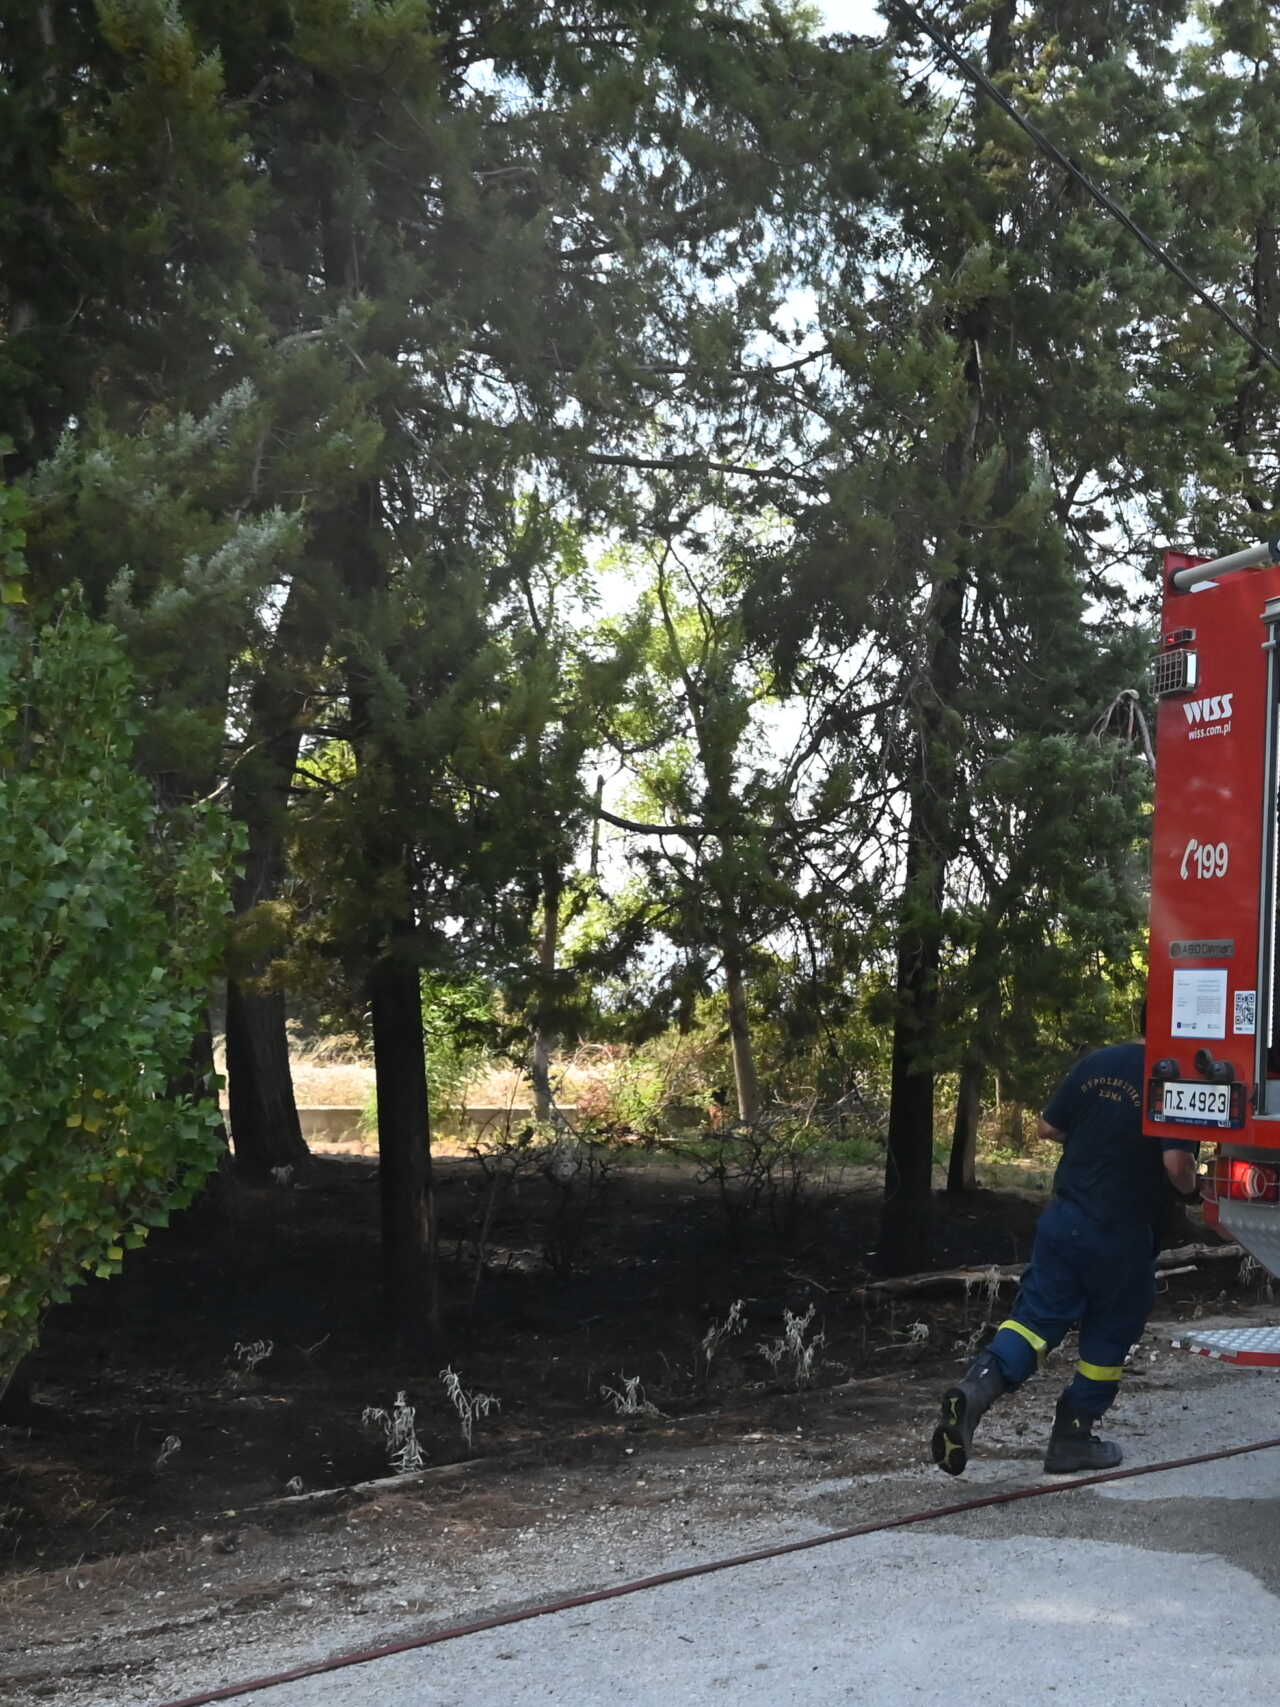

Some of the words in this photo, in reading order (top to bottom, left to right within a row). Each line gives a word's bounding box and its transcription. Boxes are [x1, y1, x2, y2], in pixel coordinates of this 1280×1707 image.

[1183, 693, 1233, 725] WISS
[1188, 720, 1232, 740] wiss.com.pl
[1194, 842, 1229, 880] 199
